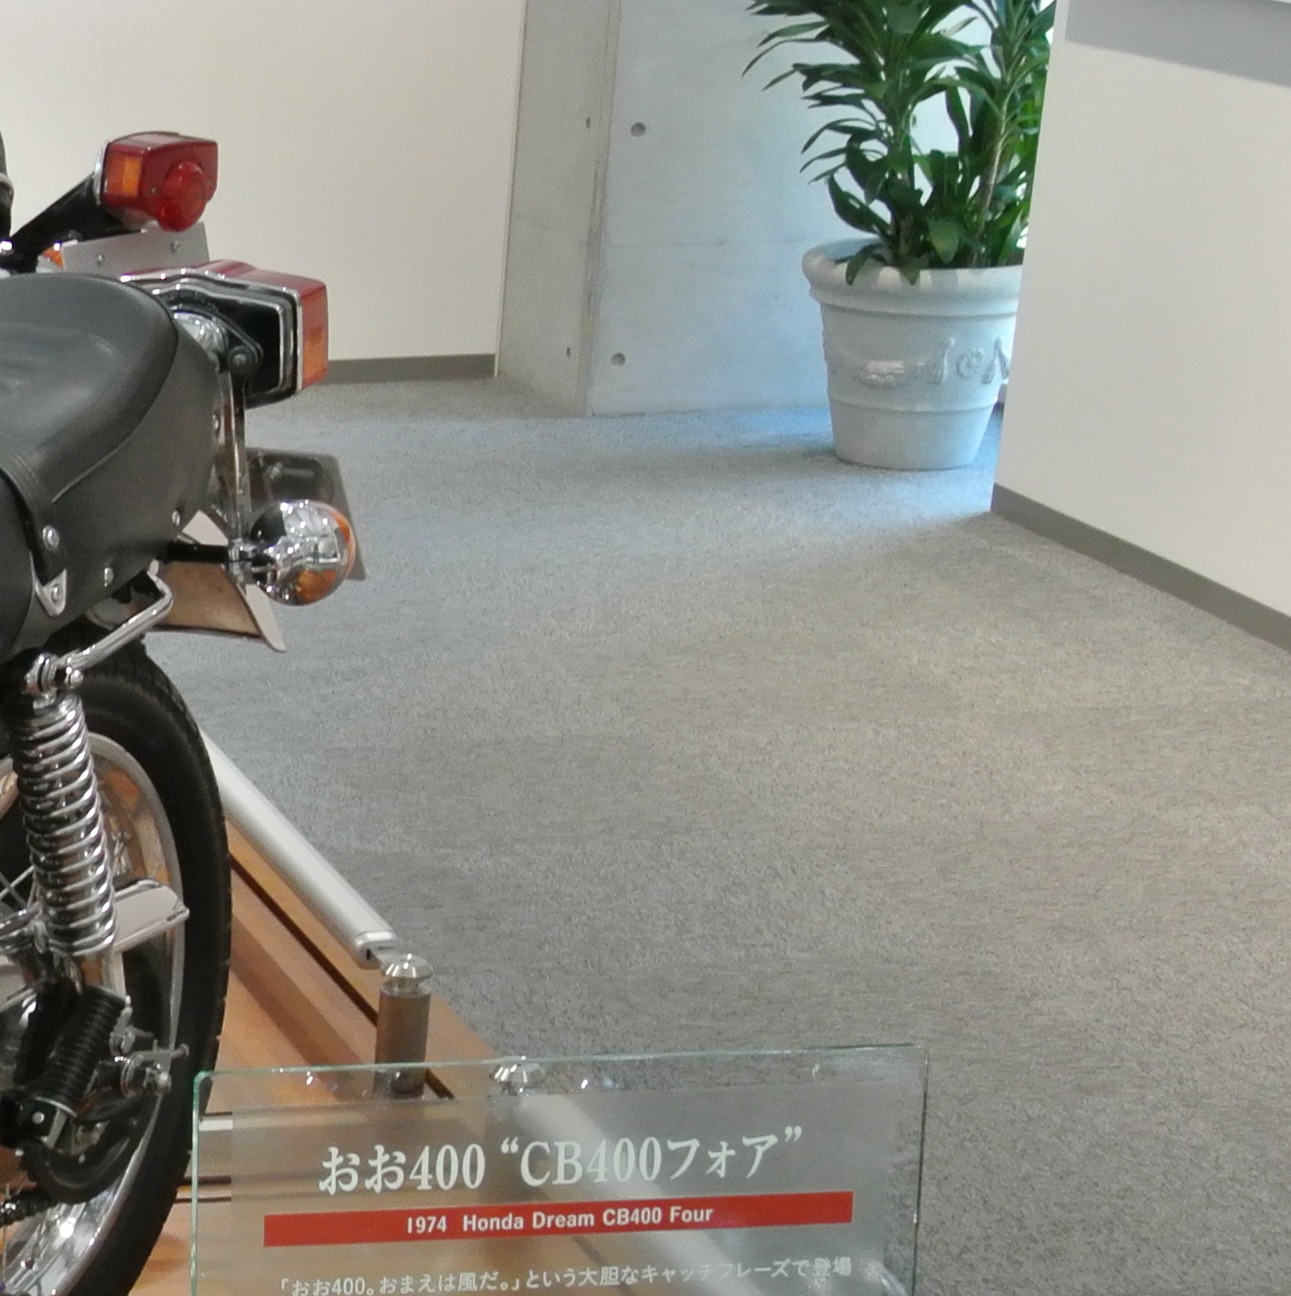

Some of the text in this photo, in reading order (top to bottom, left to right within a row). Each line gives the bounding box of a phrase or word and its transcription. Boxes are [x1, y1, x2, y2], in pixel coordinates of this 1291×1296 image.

[318, 1143, 486, 1195] おお400
[406, 1204, 714, 1235] 1974 Honda Dream CB400 Four
